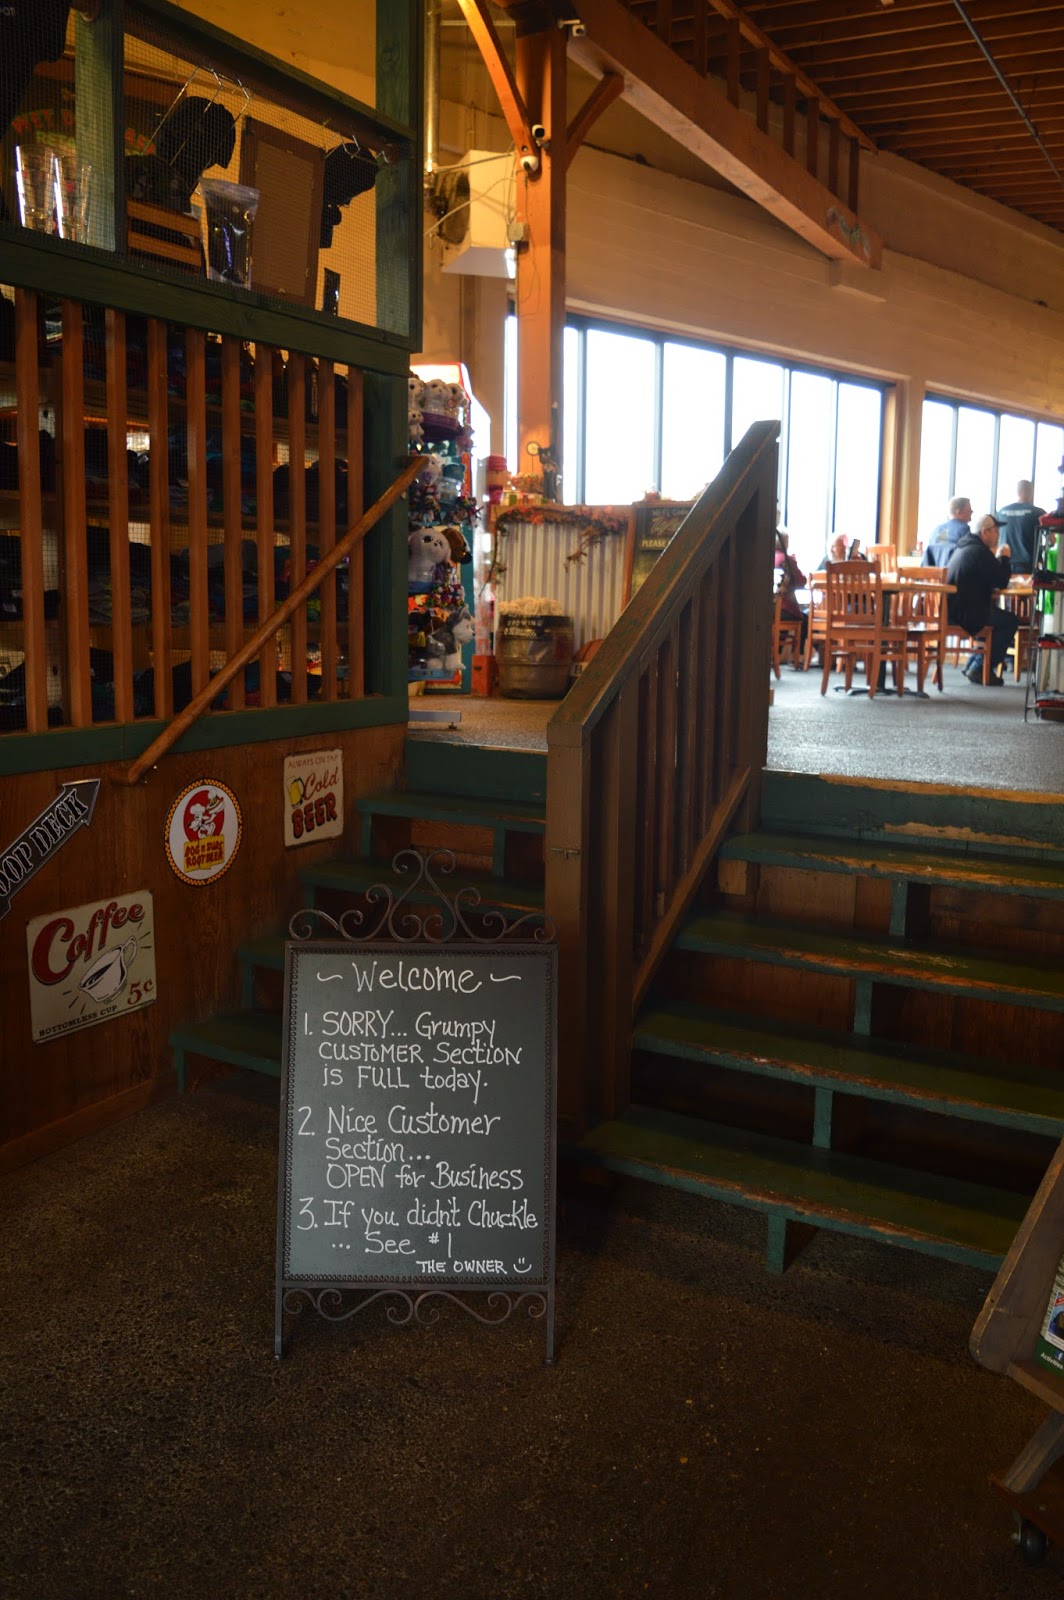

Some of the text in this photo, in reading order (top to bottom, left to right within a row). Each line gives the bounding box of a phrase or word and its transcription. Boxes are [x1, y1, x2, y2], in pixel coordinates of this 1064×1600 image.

[288, 758, 314, 769] ALWAYS
[314, 755, 325, 765] ON
[303, 766, 339, 800] Cold
[28, 788, 88, 857] DECK
[292, 792, 337, 839] BEER
[186, 853, 206, 869] ROOT
[32, 901, 145, 986] Coffee
[352, 961, 483, 993] Welcome
[39, 1005, 117, 1037] BOTTOMLESS CUP
[415, 1012, 496, 1047] Grumpy
[318, 1042, 424, 1063] CUSTOMER
[323, 1064, 489, 1104] is FULL today.
[298, 1102, 501, 1136] 2. Nice Customer
[327, 1161, 524, 1189] OPEN for Business
[297, 1197, 318, 1230] 3.
[324, 1200, 354, 1227] If
[361, 1207, 399, 1234] you
[467, 1198, 538, 1229] Chuckle
[364, 1231, 416, 1254] See
[416, 1260, 507, 1275] THE OWNER
